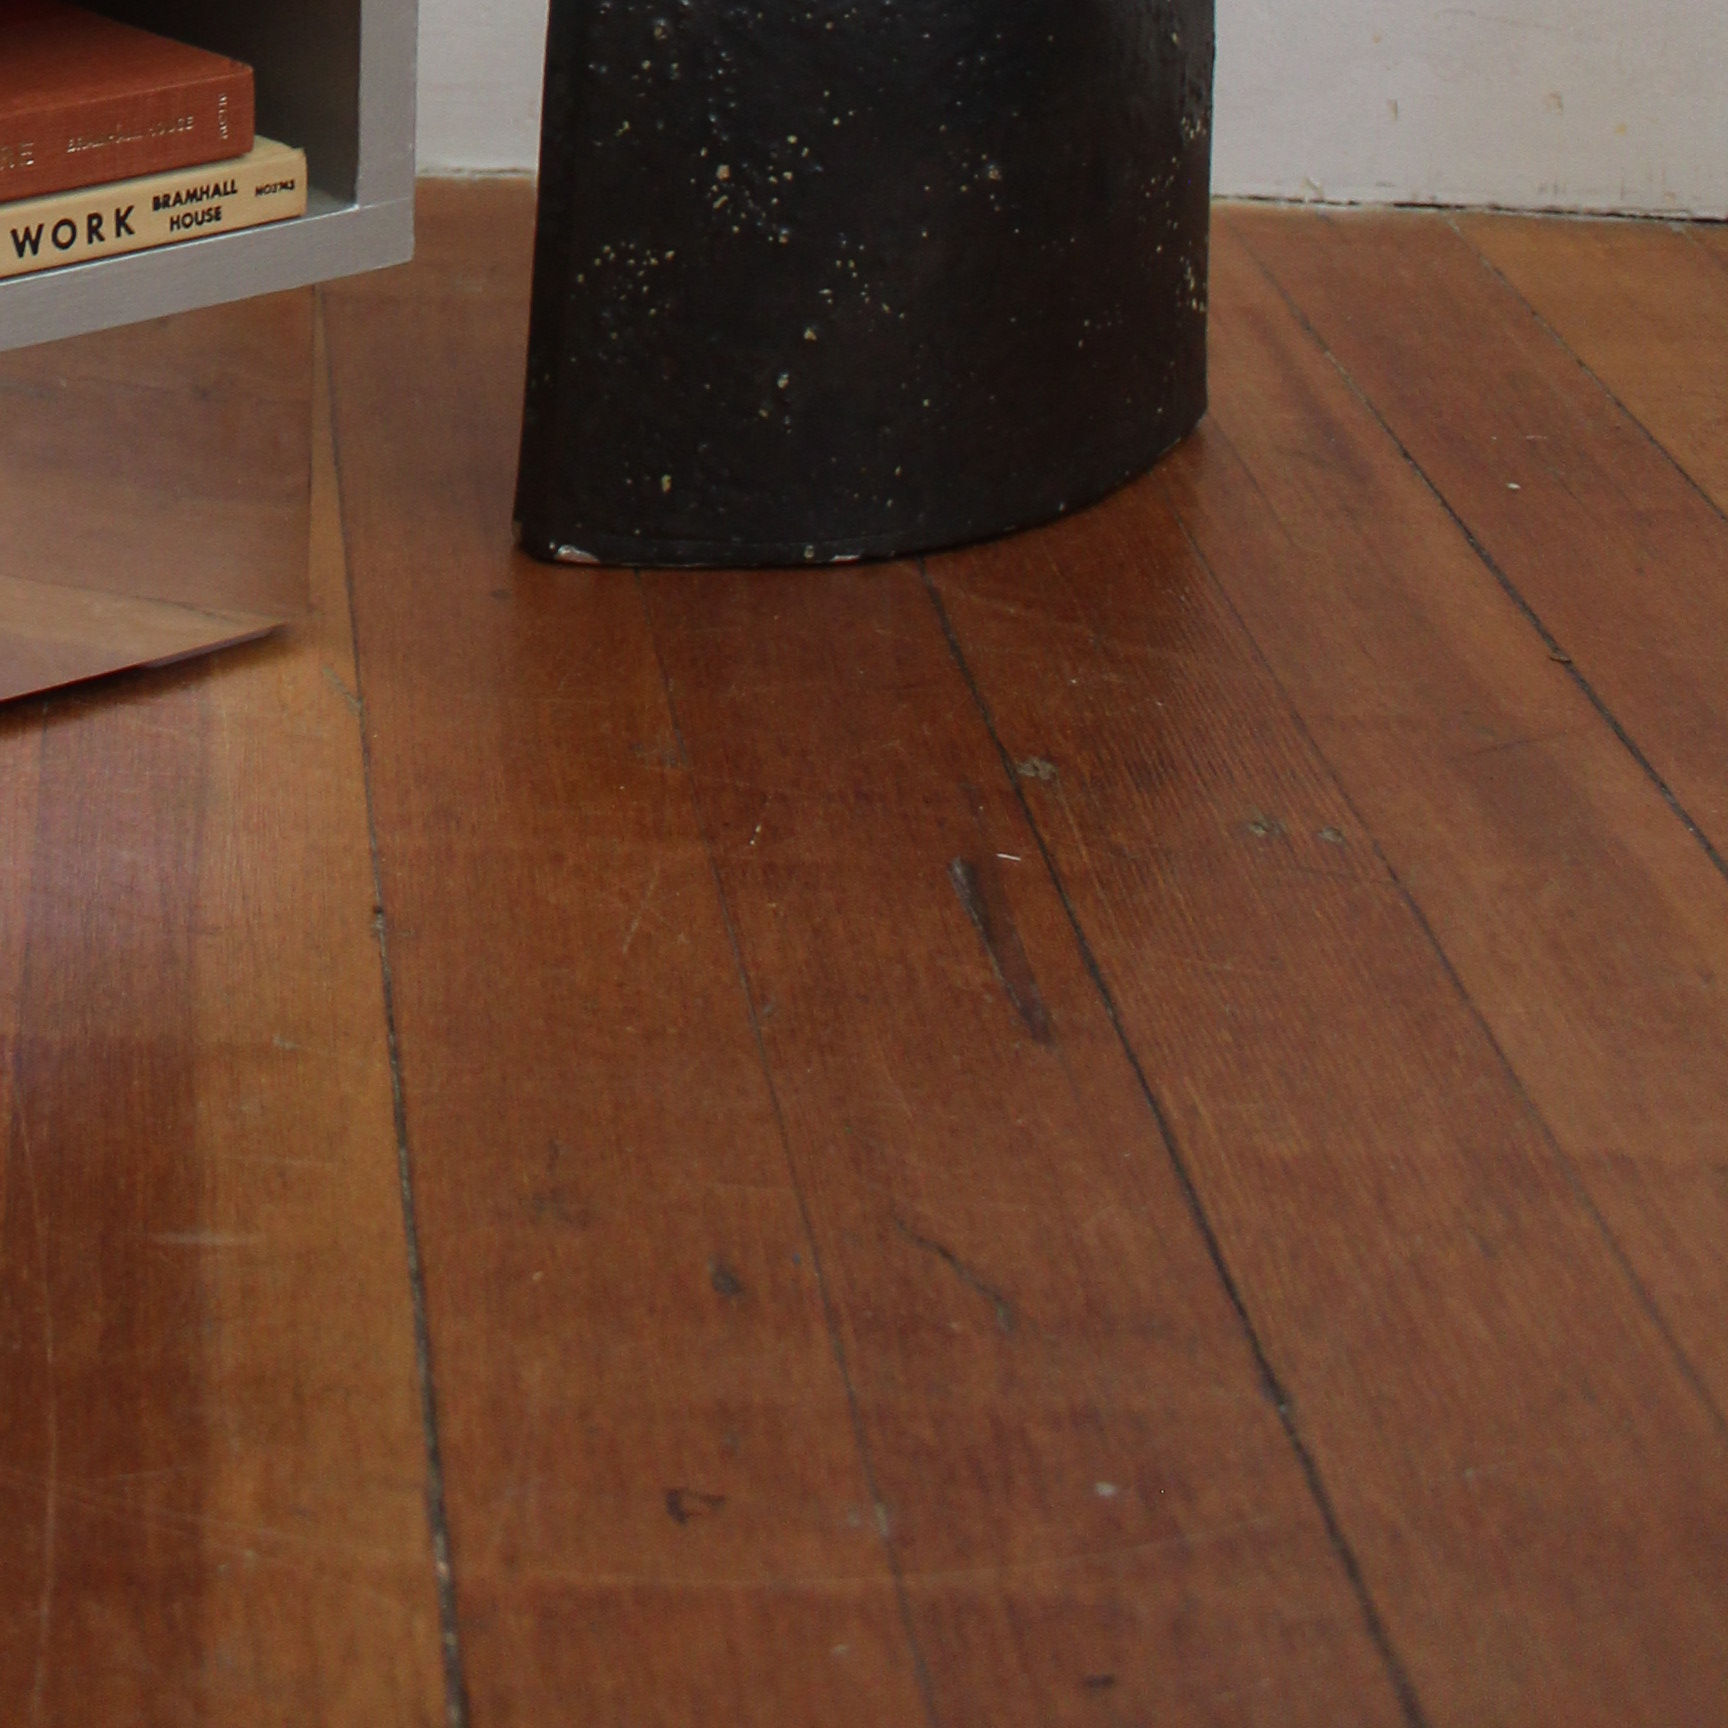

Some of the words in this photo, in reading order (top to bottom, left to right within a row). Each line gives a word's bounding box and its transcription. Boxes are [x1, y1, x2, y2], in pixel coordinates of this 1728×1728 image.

[152, 179, 238, 212] BRAMHALL
[10, 205, 137, 260] WORK
[170, 205, 222, 233] HOUSE
